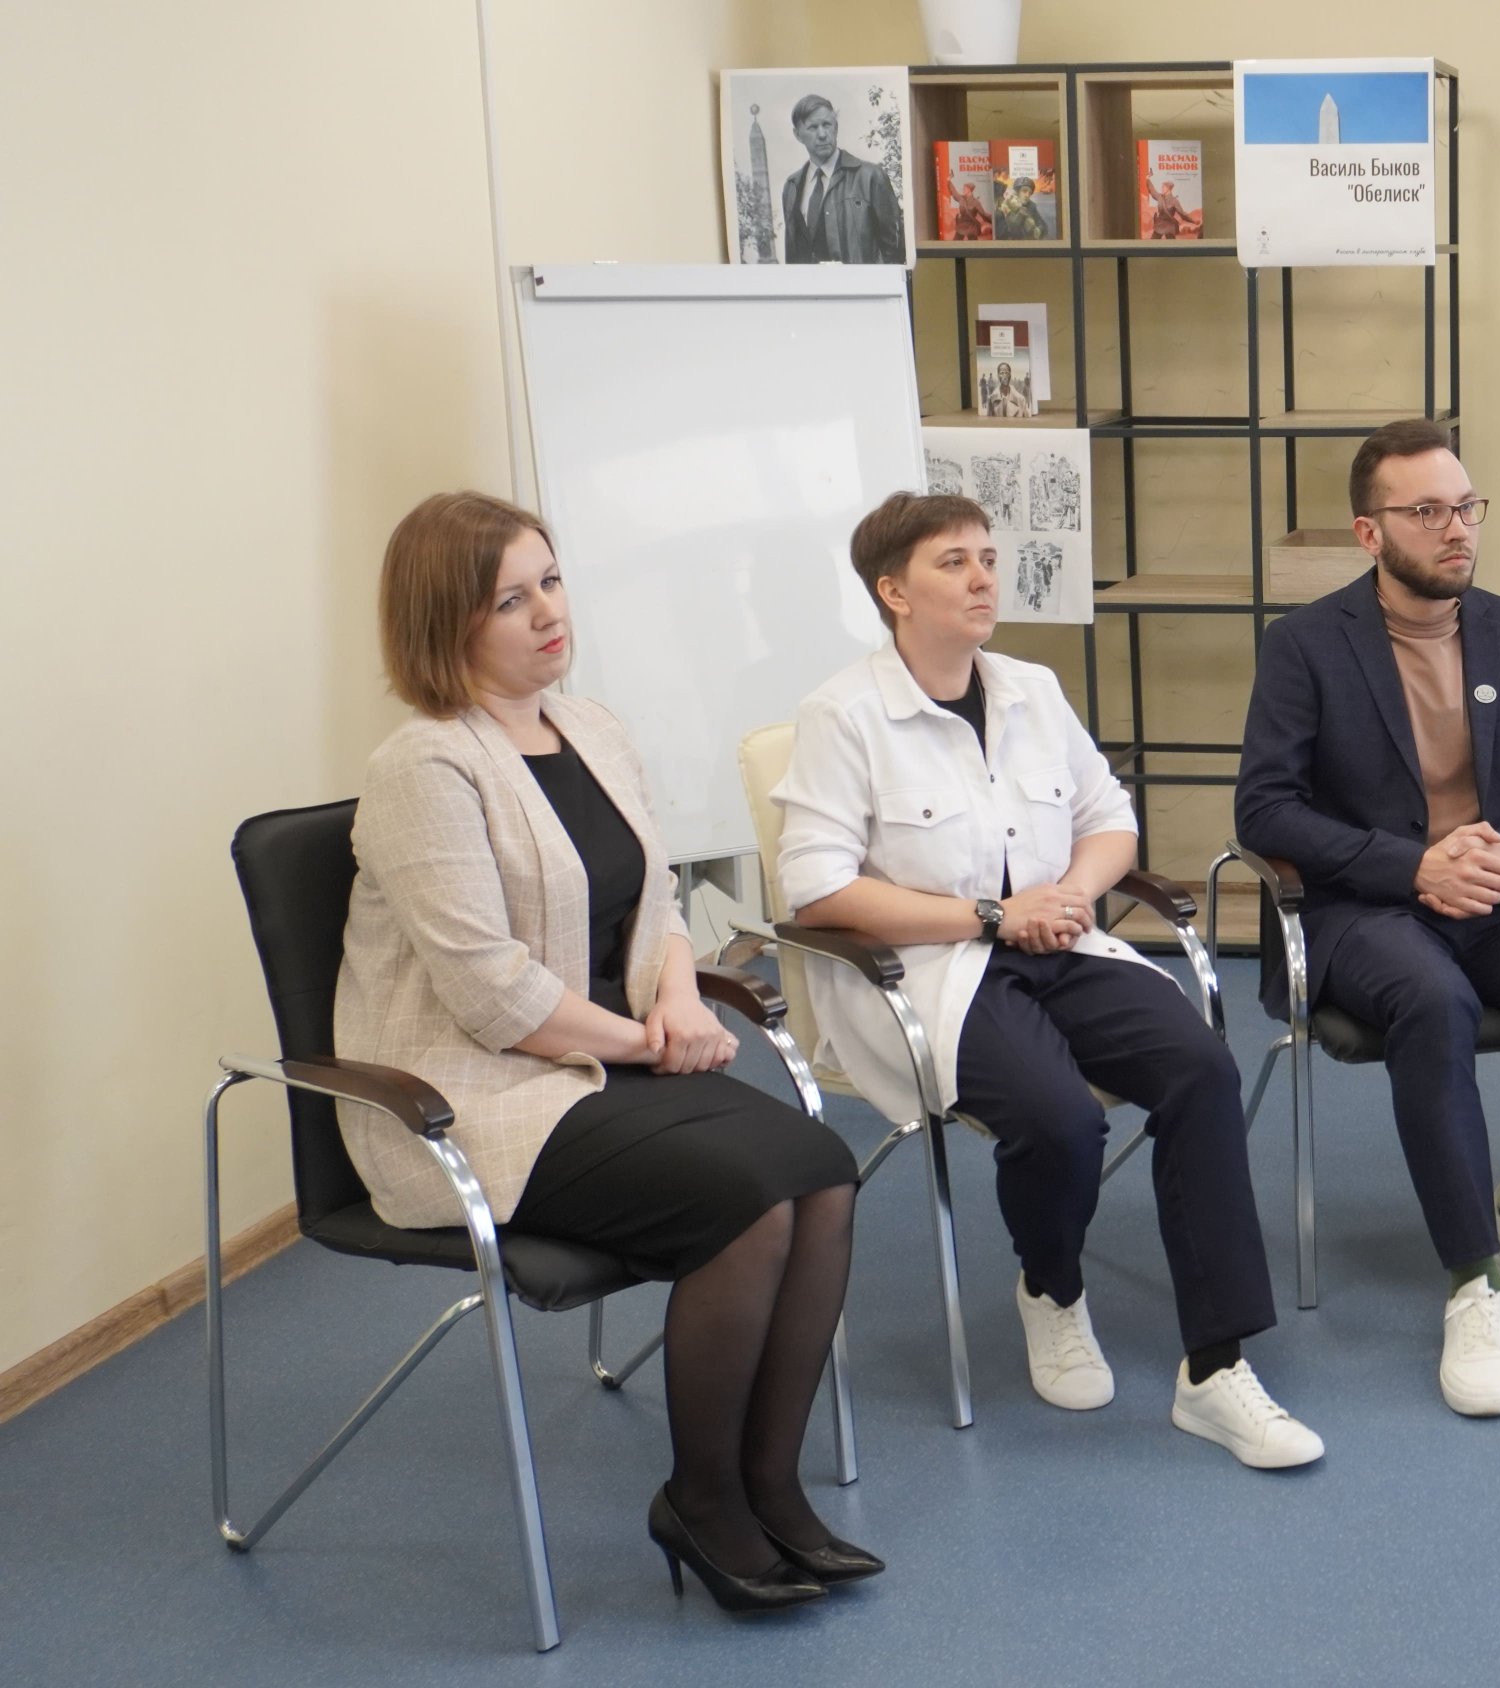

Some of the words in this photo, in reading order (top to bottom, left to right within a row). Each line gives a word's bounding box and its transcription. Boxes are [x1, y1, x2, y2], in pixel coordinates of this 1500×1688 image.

[959, 164, 992, 172] БЫКО
[1158, 162, 1198, 171] БЫКОВ
[1310, 158, 1366, 177] Василь
[1371, 157, 1420, 177] Быков
[1347, 183, 1426, 203] "Обелиск"
